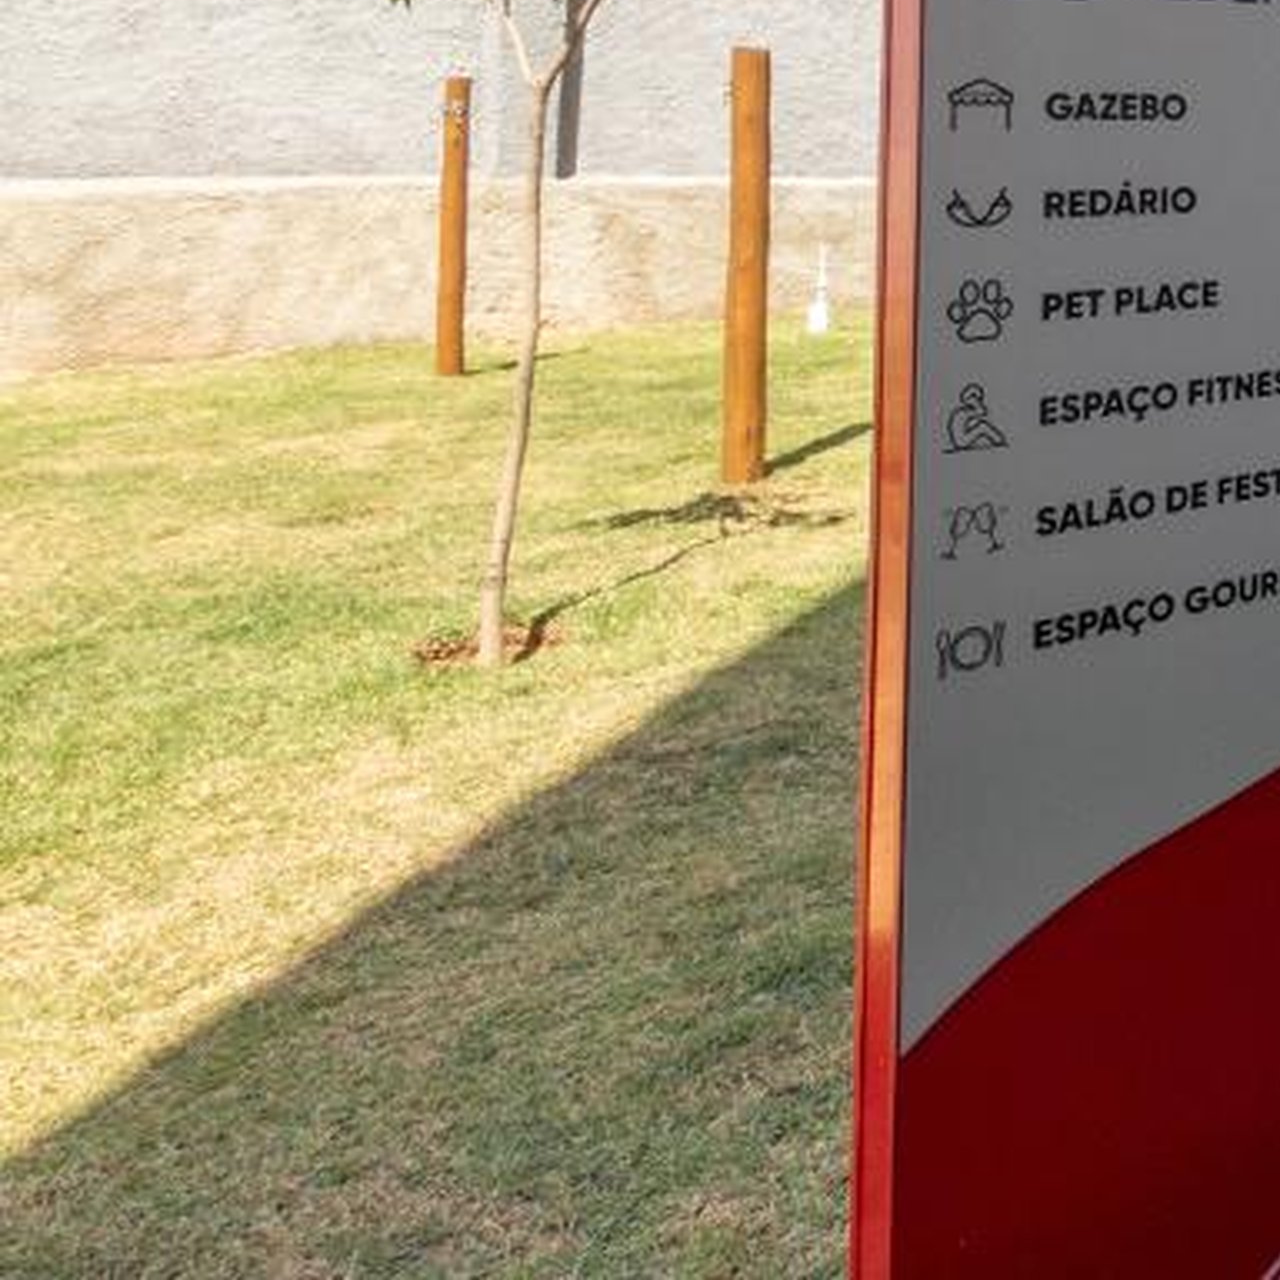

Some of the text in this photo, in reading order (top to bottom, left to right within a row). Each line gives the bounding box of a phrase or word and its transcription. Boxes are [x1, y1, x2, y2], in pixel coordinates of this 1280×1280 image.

[1044, 92, 1188, 122] GAZEBO
[1043, 180, 1198, 220] REDÁRIO
[1041, 280, 1219, 321] PET PLACE
[1039, 381, 1179, 427] ESPAÇO
[1035, 485, 1156, 538] SALÃO
[1165, 479, 1208, 514] DE
[1032, 592, 1176, 651] ESPAÇO
